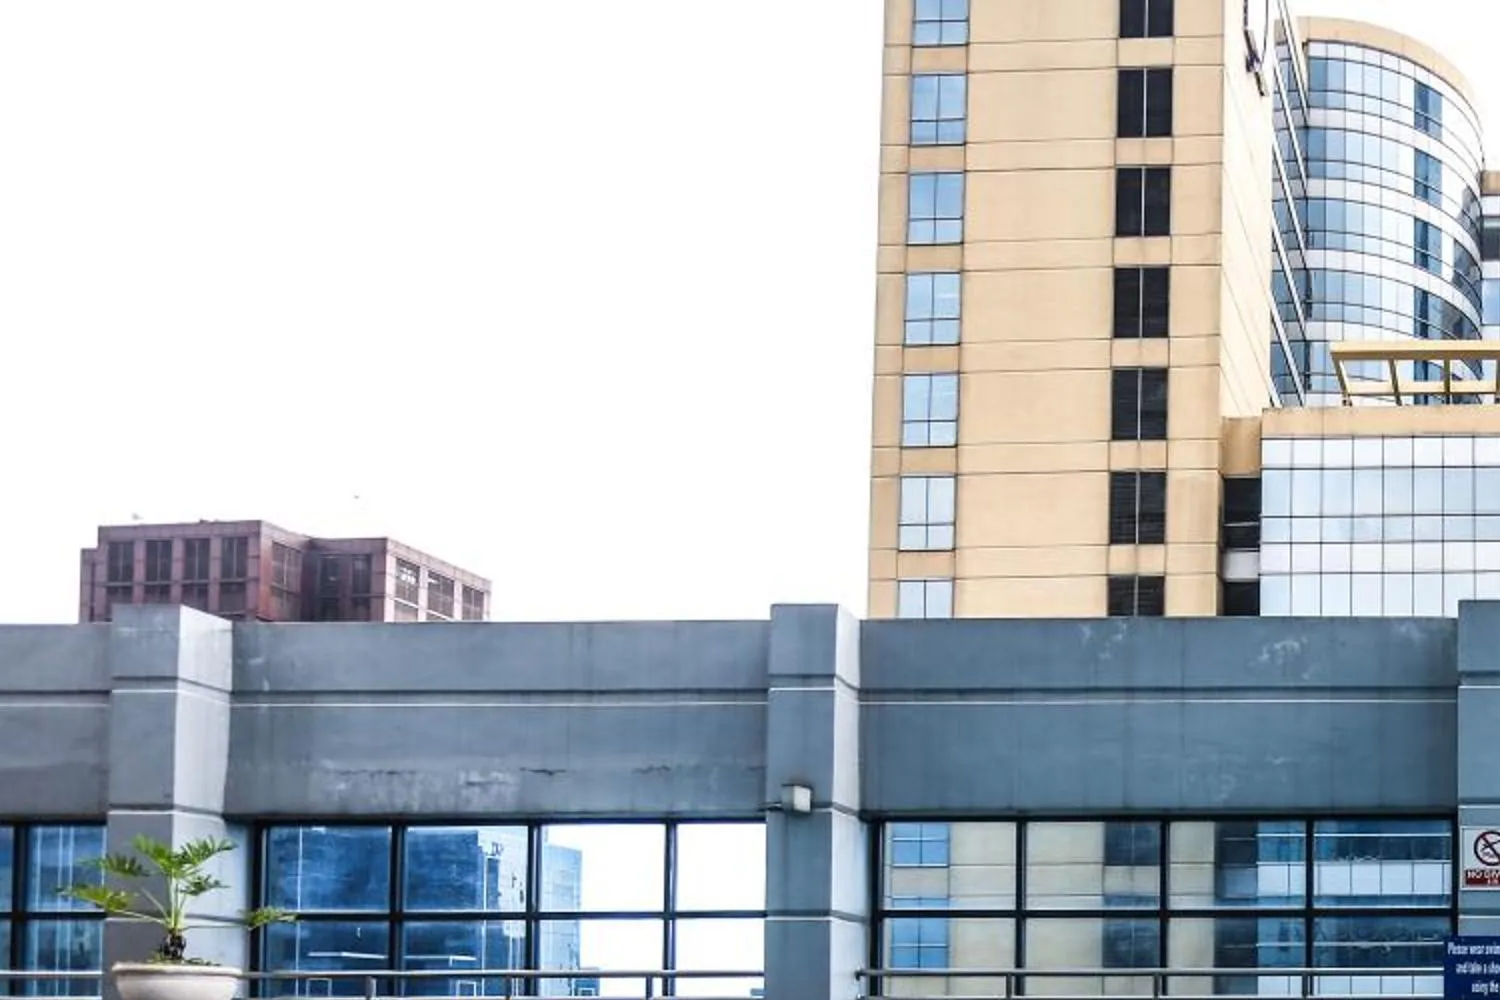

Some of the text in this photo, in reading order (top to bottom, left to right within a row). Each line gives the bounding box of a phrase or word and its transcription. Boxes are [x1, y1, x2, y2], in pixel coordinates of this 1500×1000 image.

[1467, 870, 1482, 879] NO
[1447, 942, 1468, 955] Please
[1469, 945, 1485, 955] wear
[1455, 961, 1467, 974] and
[1471, 981, 1488, 997] using
[1489, 980, 1499, 993] the
